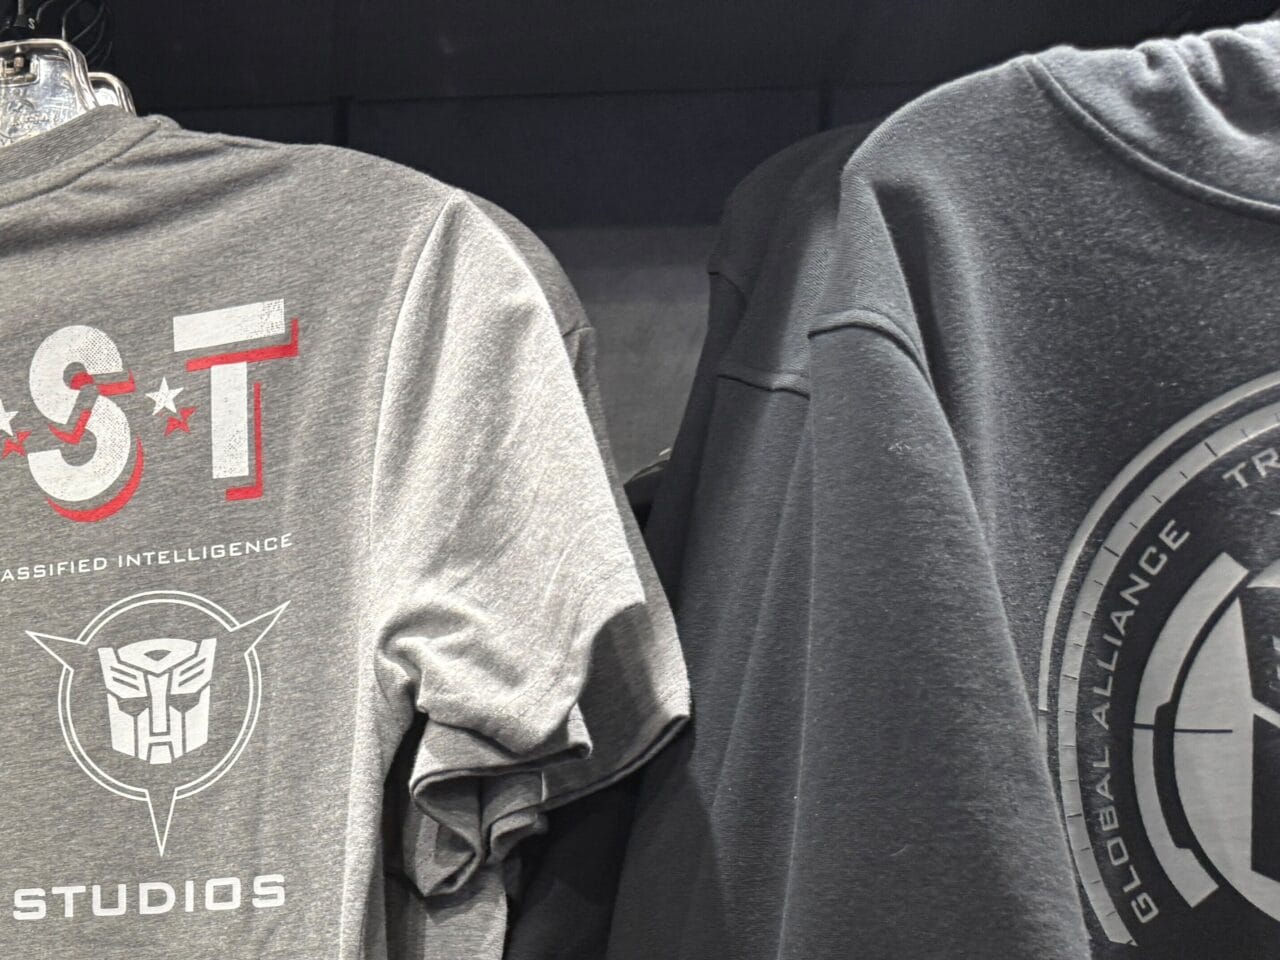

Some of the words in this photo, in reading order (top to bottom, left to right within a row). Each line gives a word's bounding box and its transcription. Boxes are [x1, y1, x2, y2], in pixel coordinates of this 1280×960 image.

[118, 532, 293, 568] INTELLIGENCE
[1092, 519, 1190, 731] ALLIANCE
[1092, 746, 1160, 924] GLOBAL
[12, 873, 286, 921] STUDIOS
